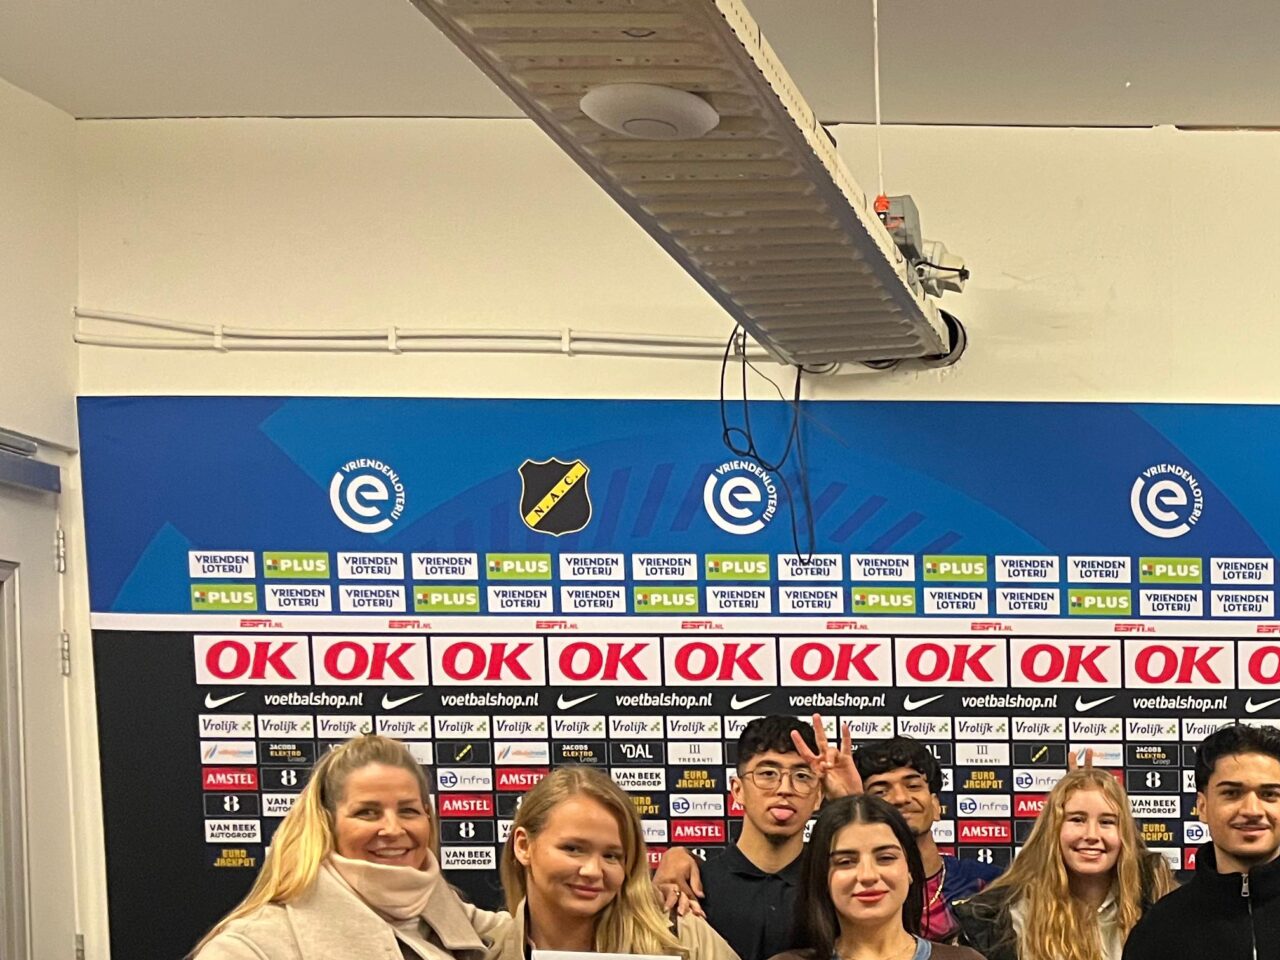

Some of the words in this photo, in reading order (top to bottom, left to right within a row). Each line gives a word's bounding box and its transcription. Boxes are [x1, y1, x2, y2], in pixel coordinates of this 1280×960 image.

[341, 458, 406, 520] VRIENDENLOTERIJ
[715, 460, 778, 522] VRIENDENLOTERIJ
[1142, 463, 1204, 525] VRIENDENLOTERIJ
[194, 555, 249, 564] VRIENDEN
[280, 559, 327, 573] PLUS
[417, 557, 472, 566] VRIENDEN
[638, 557, 692, 567] VRIENDEN
[1000, 559, 1054, 569] VRIENDEN
[201, 564, 243, 574] LOTERIJ
[424, 566, 466, 576] LOTERIJ
[645, 566, 685, 577] LOTERIJ
[720, 561, 767, 574] PLUS
[1007, 568, 1047, 578] LOTERIJ
[1154, 564, 1200, 577] PLUS
[207, 590, 255, 604] PLUS
[271, 588, 326, 598] VRIENDEN
[566, 590, 620, 599] VRIENDEN
[929, 591, 983, 601] VRIENDEN
[1216, 594, 1269, 603] VRIENDEN
[277, 597, 319, 608] LOTERIJ
[573, 599, 614, 609] LOTERIJ
[650, 593, 697, 607] PLUS
[866, 594, 913, 607] PLUS
[936, 600, 976, 610] LOTERIJ
[1083, 596, 1129, 609] PLUS
[1223, 603, 1262, 613] LOTERIJ
[205, 640, 298, 680] OK
[323, 640, 415, 681] OK
[441, 641, 533, 681] OK
[558, 641, 650, 681] OK
[674, 641, 766, 681] OK
[790, 642, 881, 682] OK
[905, 642, 996, 682] OK
[1020, 643, 1111, 683] OK
[1134, 644, 1224, 684] OK
[264, 692, 363, 708] voetbalshop.nl
[440, 693, 539, 709] voetbalshop.nl
[615, 693, 713, 709] voetbalshop.nl
[788, 693, 886, 709] voetbalshop.nl
[961, 694, 1058, 711] voetbalshop.nl
[1132, 696, 1228, 712] voetbalshop.nl
[202, 719, 239, 734] Vrolijk
[320, 720, 357, 734] Vrolijk
[438, 720, 474, 734] Vrolijk
[554, 720, 590, 735] Vrolijk
[670, 720, 706, 735] Vrolijk
[958, 721, 993, 736] Vrolijk
[1129, 723, 1164, 737] Vrolijk
[206, 773, 254, 785] AMSTEL
[683, 770, 708, 779] EURO
[970, 771, 995, 780] EURO
[443, 799, 490, 811] AMSTEL
[1132, 799, 1150, 807] VAN
[1153, 799, 1177, 807] BEEK
[209, 823, 229, 832] VAN
[232, 823, 256, 832] BEEK
[674, 825, 721, 837] AMSTEL
[961, 826, 1008, 837] AMSTEL
[221, 849, 246, 858] EURO
[445, 850, 465, 858] VAN
[468, 851, 492, 859] BEEK
[445, 858, 492, 866] AUTOGROEP
